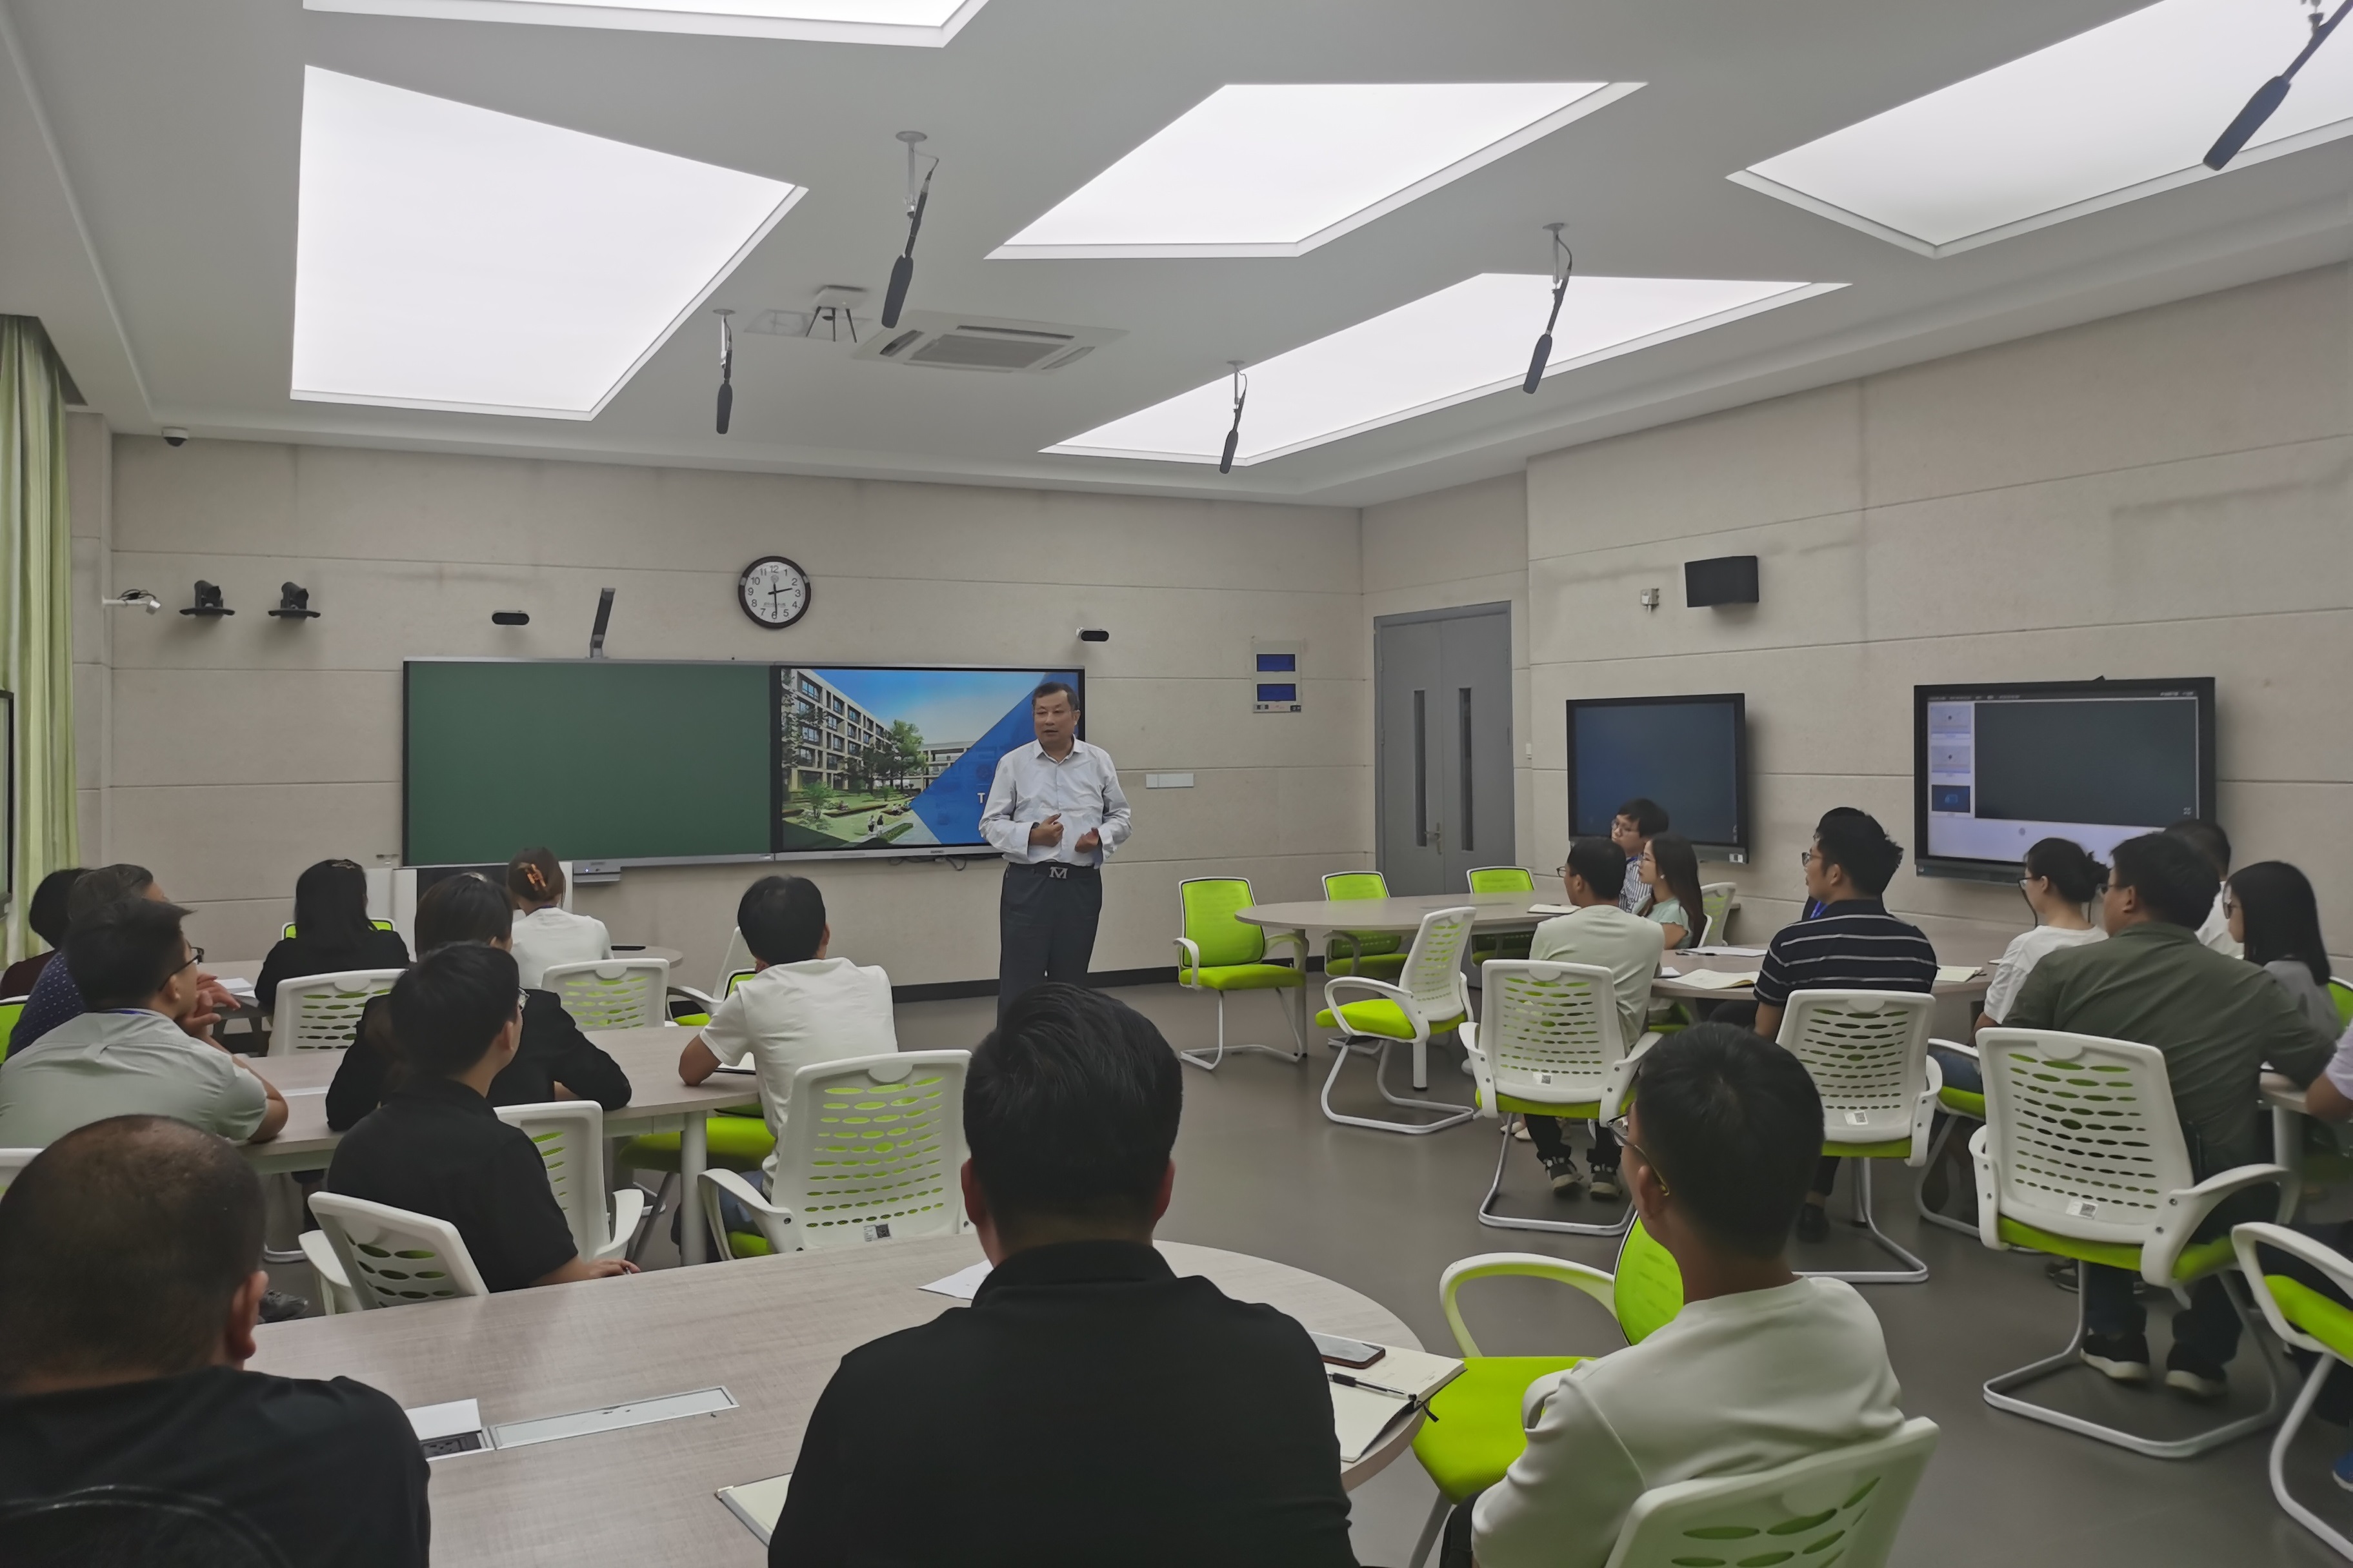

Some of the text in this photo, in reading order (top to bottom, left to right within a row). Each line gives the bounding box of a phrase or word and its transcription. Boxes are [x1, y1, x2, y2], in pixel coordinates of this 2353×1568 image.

[770, 565, 779, 573] 12
[784, 568, 788, 577] 1
[751, 577, 761, 585] 10
[795, 589, 801, 597] 3
[751, 599, 757, 607] 8
[792, 600, 797, 609] 4
[760, 608, 766, 616] 7
[783, 609, 789, 617] 5
